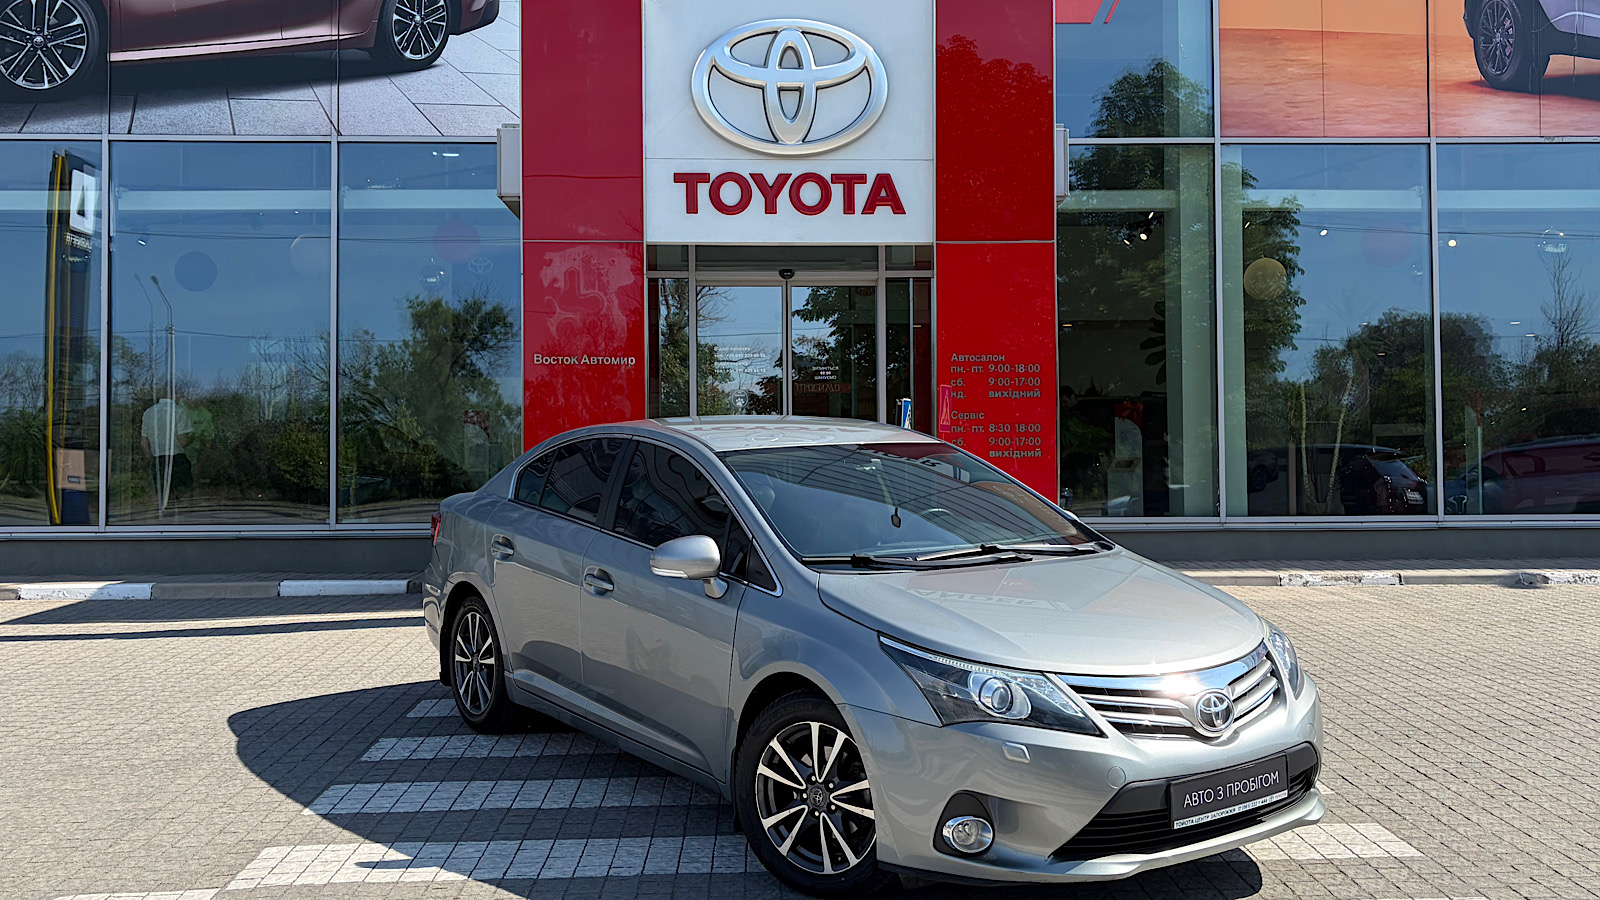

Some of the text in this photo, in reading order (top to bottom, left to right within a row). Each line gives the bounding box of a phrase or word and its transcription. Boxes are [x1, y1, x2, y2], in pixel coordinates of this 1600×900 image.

[673, 171, 907, 216] TOYOTA
[533, 353, 636, 367] Восток Автомир
[951, 353, 1006, 362] Автосалон
[950, 378, 966, 387] сб.
[950, 388, 1041, 399] нд. вихідний
[951, 411, 985, 421] Сервіс
[989, 448, 1042, 459] вихідний
[1183, 771, 1280, 808] АВТО З ПРОБІГОМ
